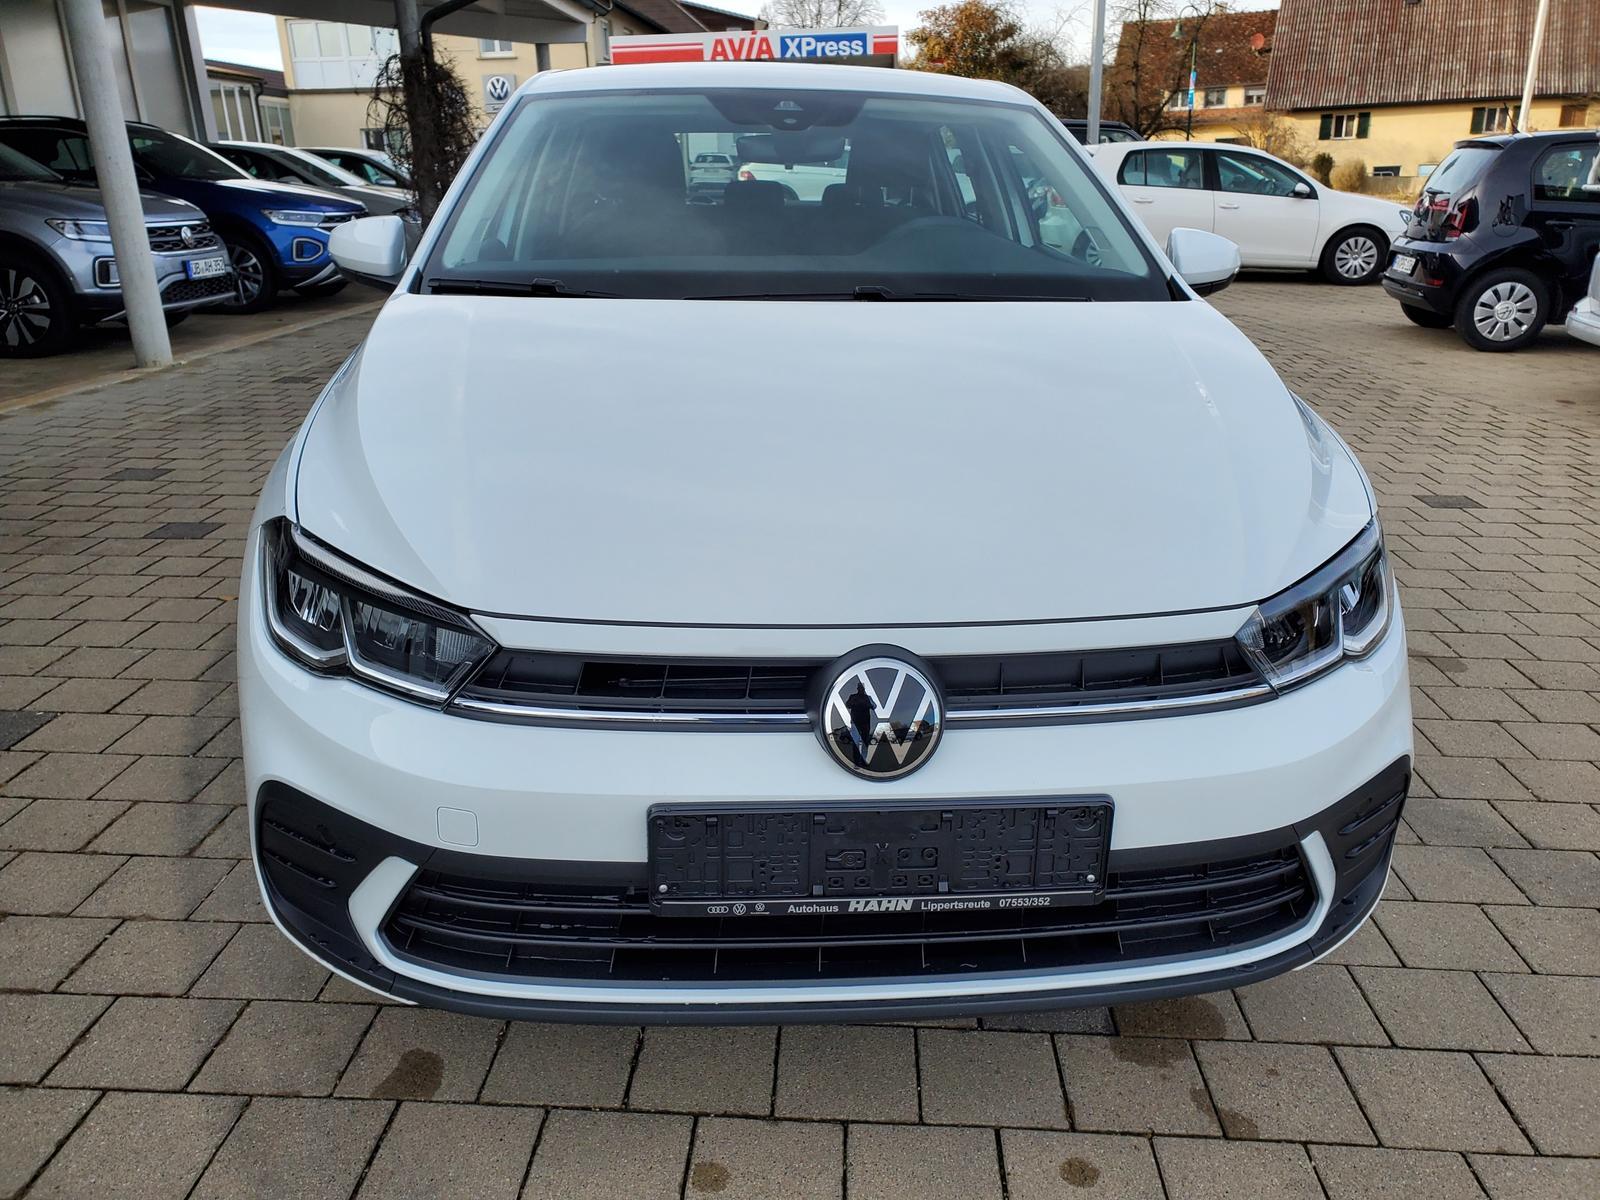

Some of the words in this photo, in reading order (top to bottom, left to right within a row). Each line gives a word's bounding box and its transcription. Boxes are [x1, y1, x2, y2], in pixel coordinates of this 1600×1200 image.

[711, 31, 776, 60] AVIA
[785, 37, 864, 58] XPress
[787, 903, 839, 913] Autohaus
[848, 898, 914, 912] HAHN
[920, 900, 991, 911] Lippertsreute
[999, 896, 1051, 908] 07553/352
